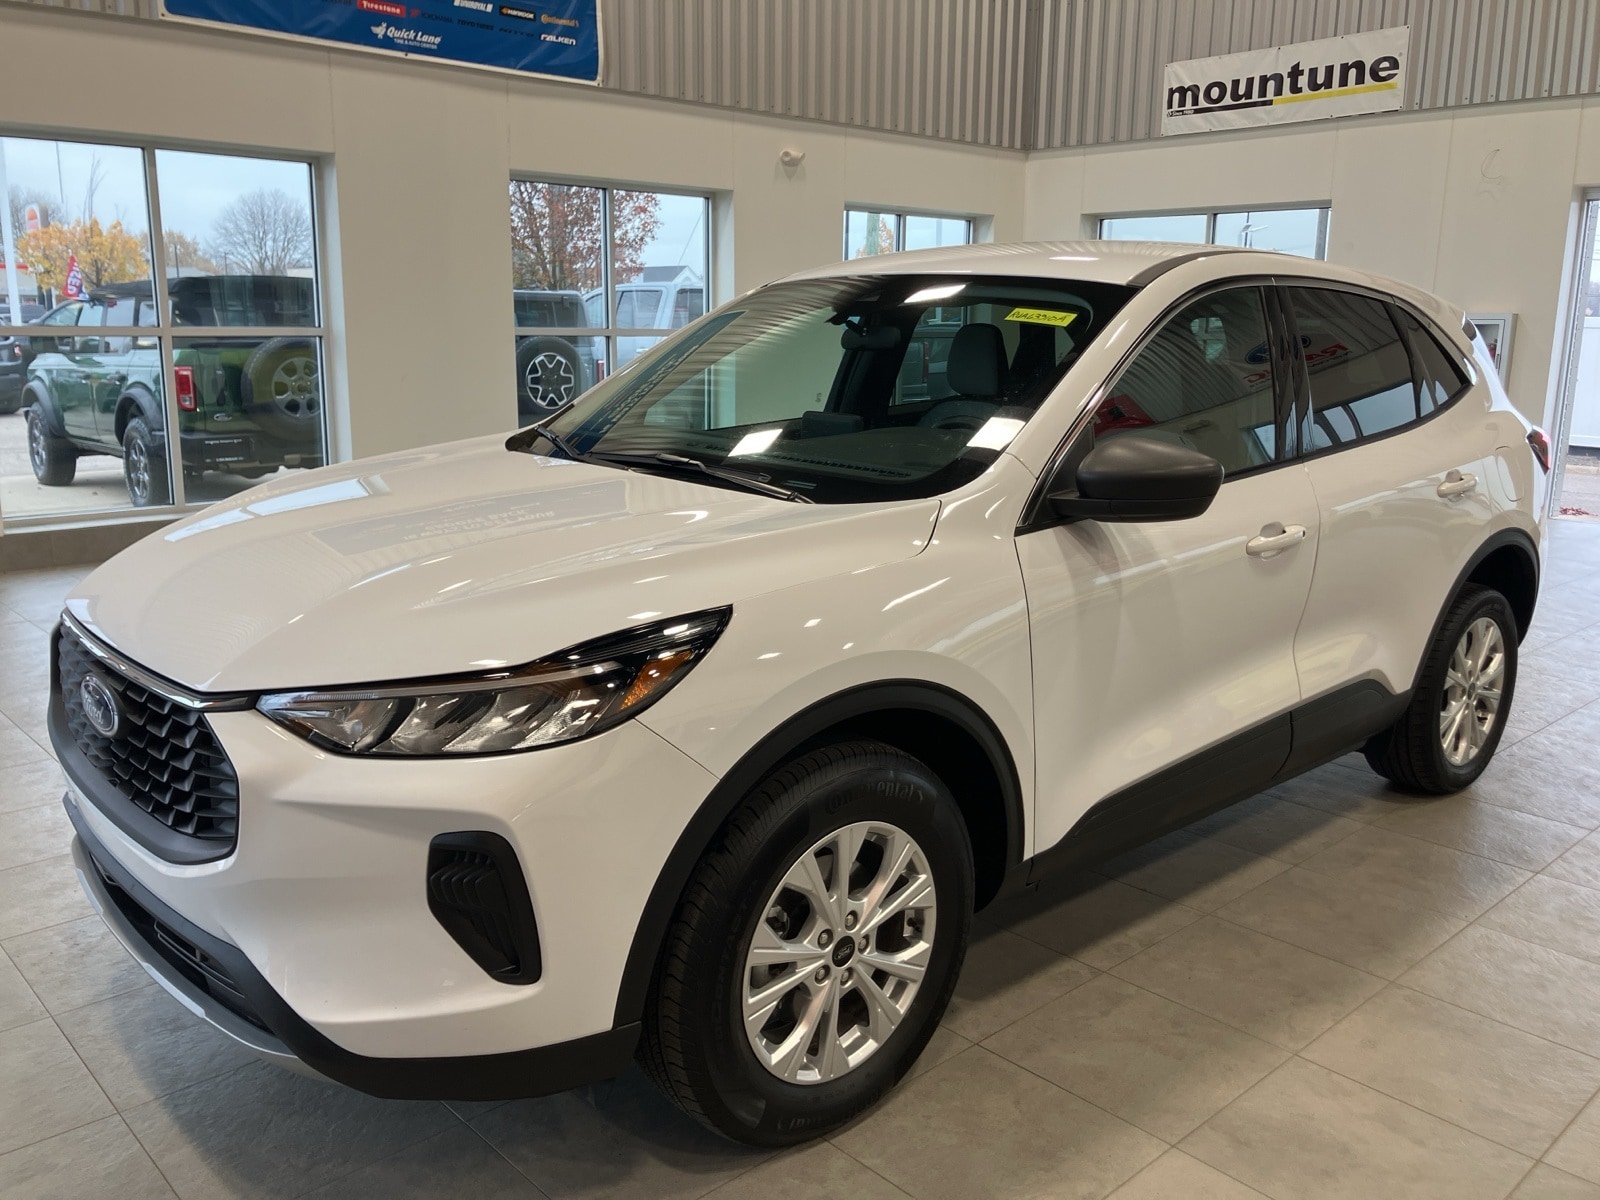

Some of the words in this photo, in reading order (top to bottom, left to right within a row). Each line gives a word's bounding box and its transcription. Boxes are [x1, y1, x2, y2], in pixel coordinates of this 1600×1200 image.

[362, 0, 401, 14] Firestone
[386, 25, 416, 40] Quick
[416, 31, 442, 45] Lane
[1167, 55, 1400, 110] mountune
[824, 781, 923, 814] Connental
